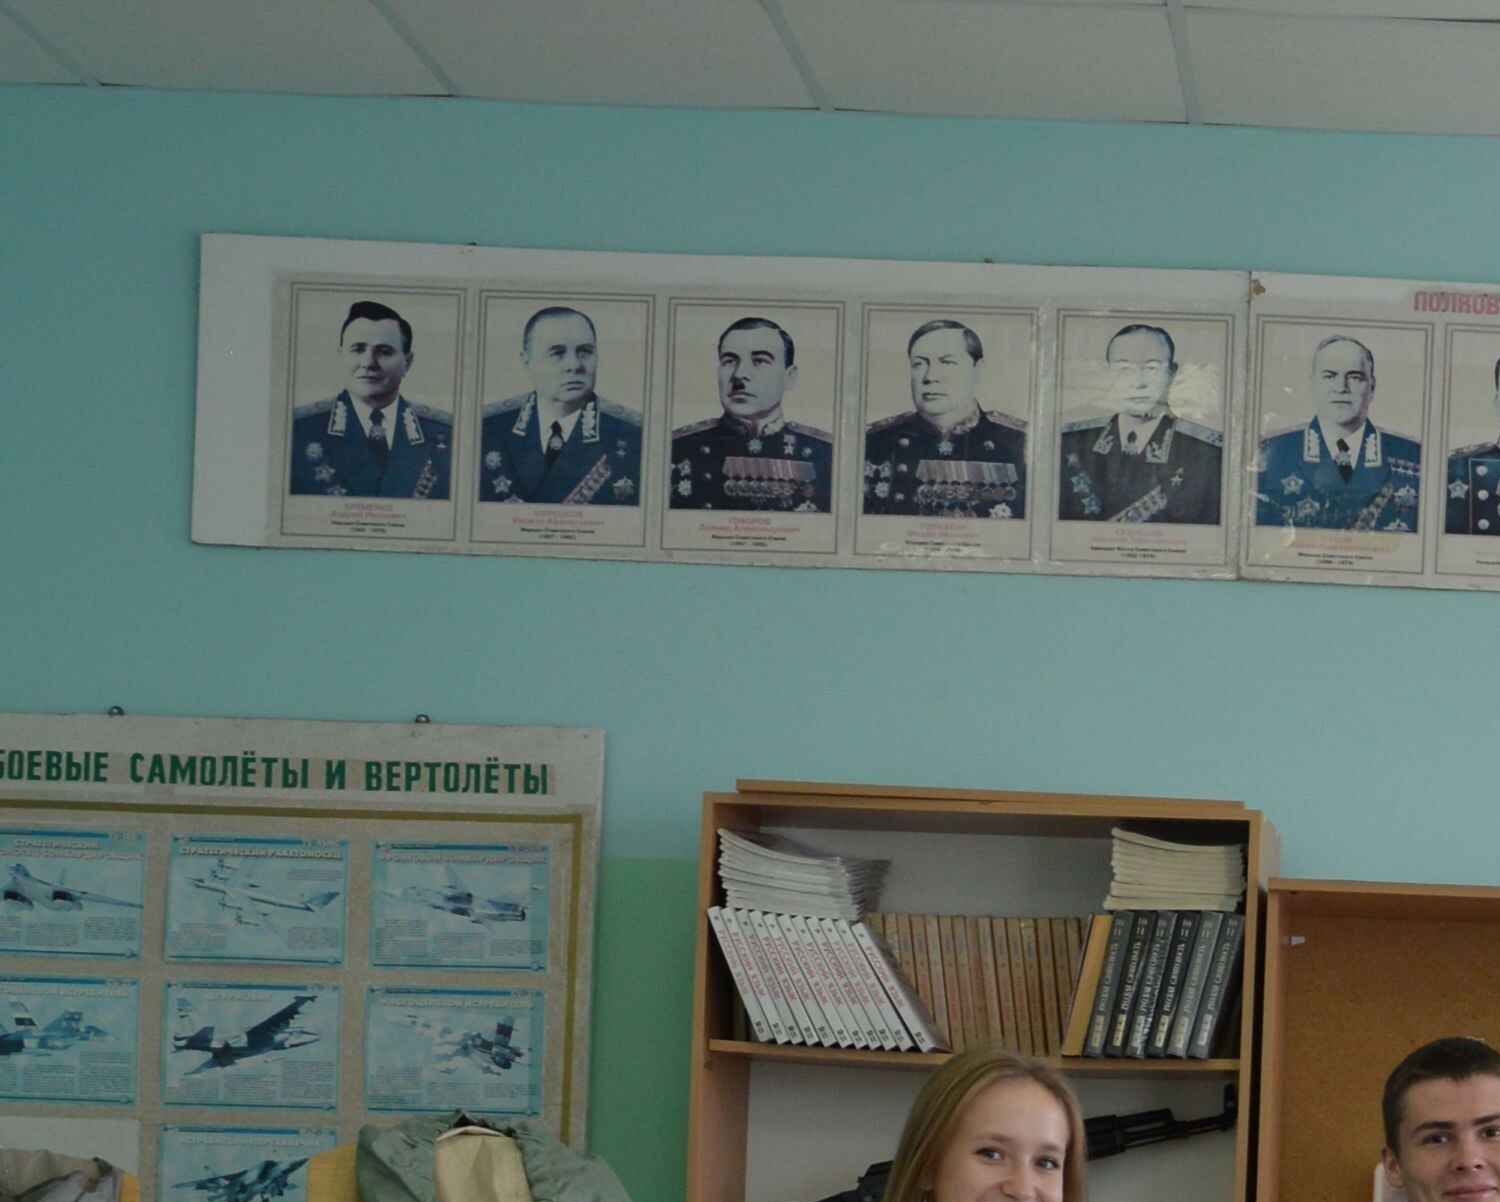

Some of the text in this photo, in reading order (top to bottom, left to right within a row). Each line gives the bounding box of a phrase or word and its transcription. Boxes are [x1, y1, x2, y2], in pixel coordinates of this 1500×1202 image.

[0, 750, 549, 795] ОЕВЫЕ САМОЛЁТЫ И ВЕРТОЛЁТЫ
